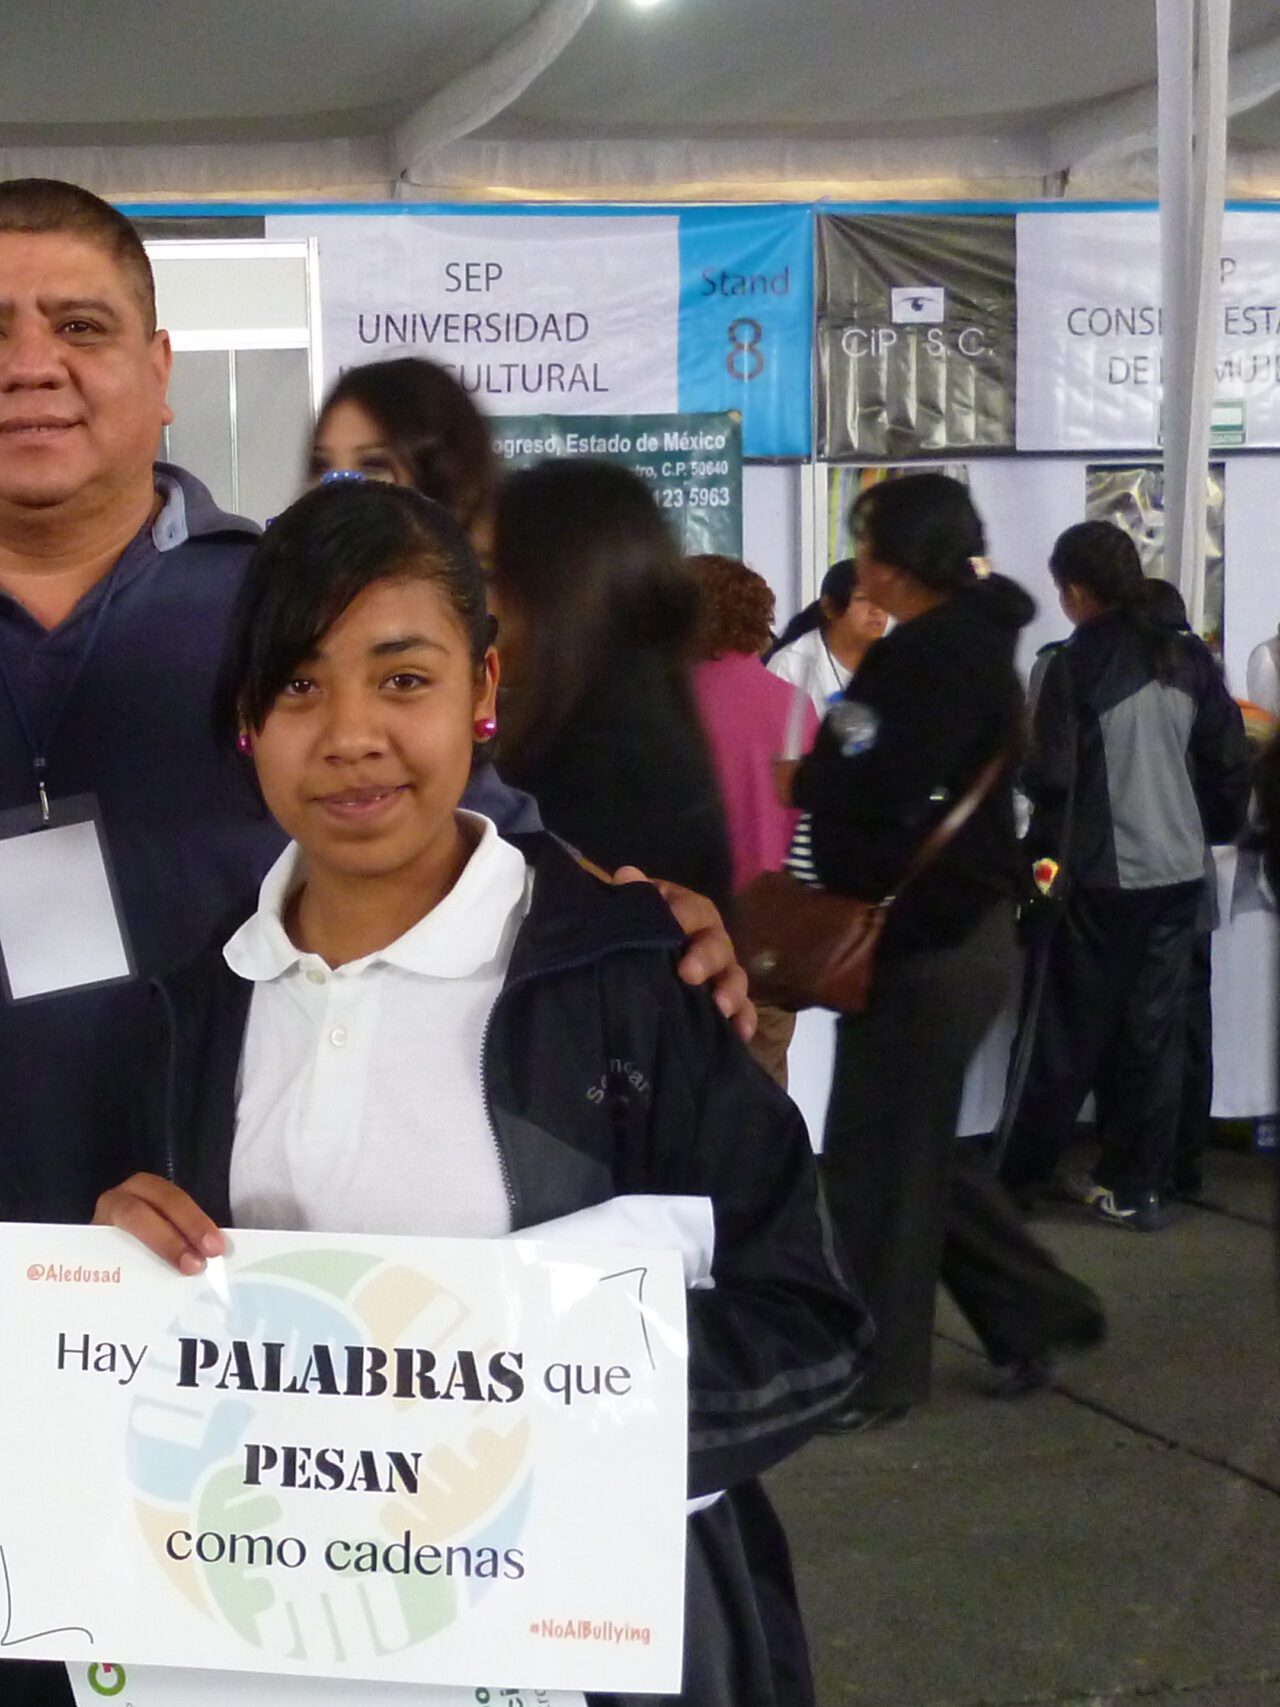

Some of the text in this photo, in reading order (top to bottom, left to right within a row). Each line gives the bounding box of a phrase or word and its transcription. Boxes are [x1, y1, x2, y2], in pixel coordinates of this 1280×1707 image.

[445, 262, 503, 293] SEP
[701, 265, 790, 297] Stand
[358, 311, 589, 344] UNIVERSIDAD
[1067, 305, 1280, 336] CONS EST
[726, 317, 765, 381] 8
[450, 363, 610, 393] ULTURAL
[1108, 356, 1149, 385] DE
[565, 433, 631, 454] Estado
[635, 432, 659, 453] de
[663, 430, 726, 452] México
[690, 460, 729, 476] 50640
[688, 486, 730, 507] 5963
[26, 1263, 121, 1284] @Aledusad
[57, 1332, 631, 1406] Hay PALABRAS que
[242, 1443, 423, 1495] PESAN
[166, 1529, 525, 1579] como cadenas
